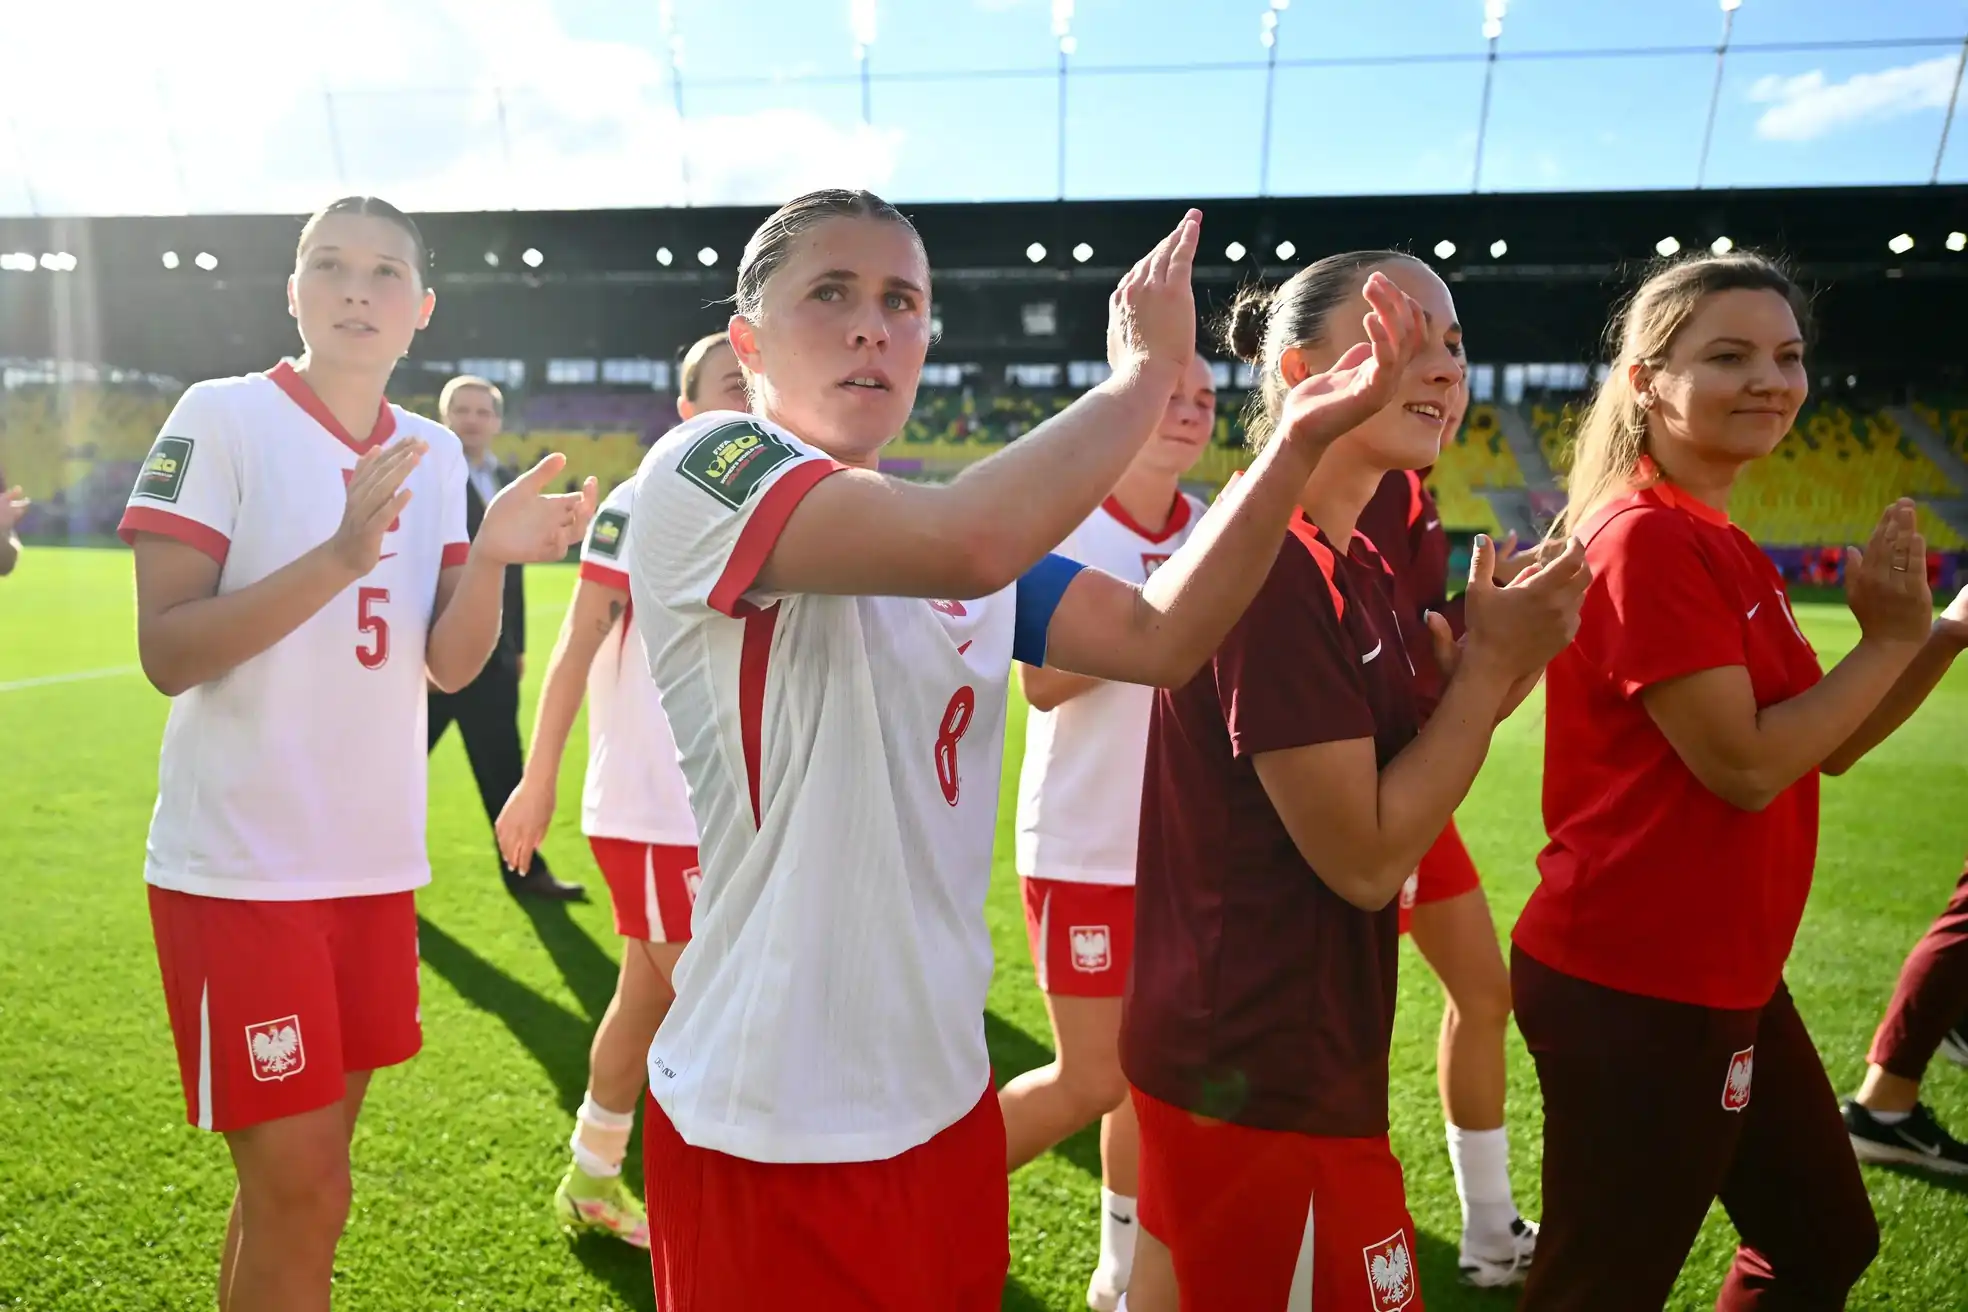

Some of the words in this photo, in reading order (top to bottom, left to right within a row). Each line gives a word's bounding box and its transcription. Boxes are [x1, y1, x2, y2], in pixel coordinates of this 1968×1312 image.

[705, 435, 760, 478] U20
[712, 440, 731, 456] FIFA
[720, 459, 740, 484] WOMEN'S
[355, 586, 390, 670] 5
[934, 685, 975, 807] 8
